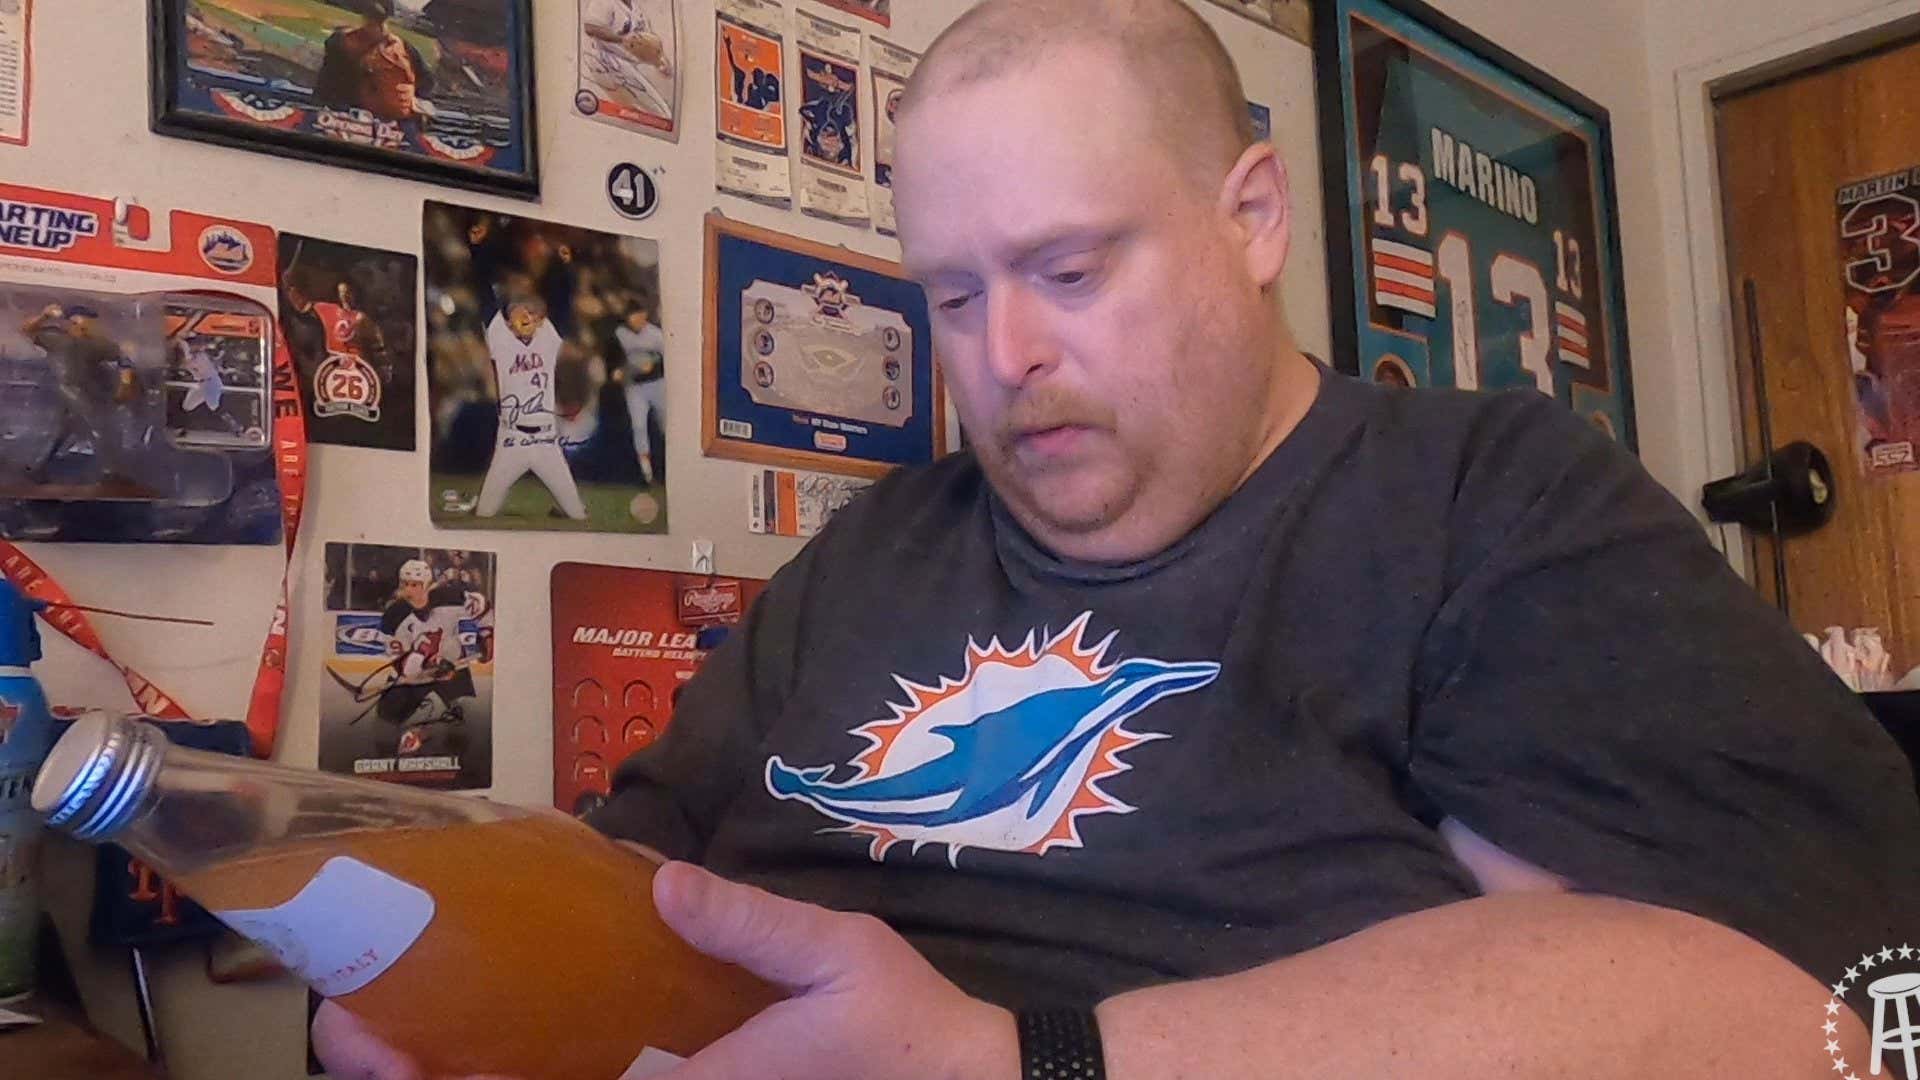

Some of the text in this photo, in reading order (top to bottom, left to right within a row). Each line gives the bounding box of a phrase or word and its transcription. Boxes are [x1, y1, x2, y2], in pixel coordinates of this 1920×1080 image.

[611, 168, 645, 207] 41
[1431, 127, 1537, 225] MARINO
[1369, 153, 1428, 236] 13
[0, 201, 95, 234] RTING
[332, 372, 364, 401] 26
[572, 626, 653, 647] MAJOR
